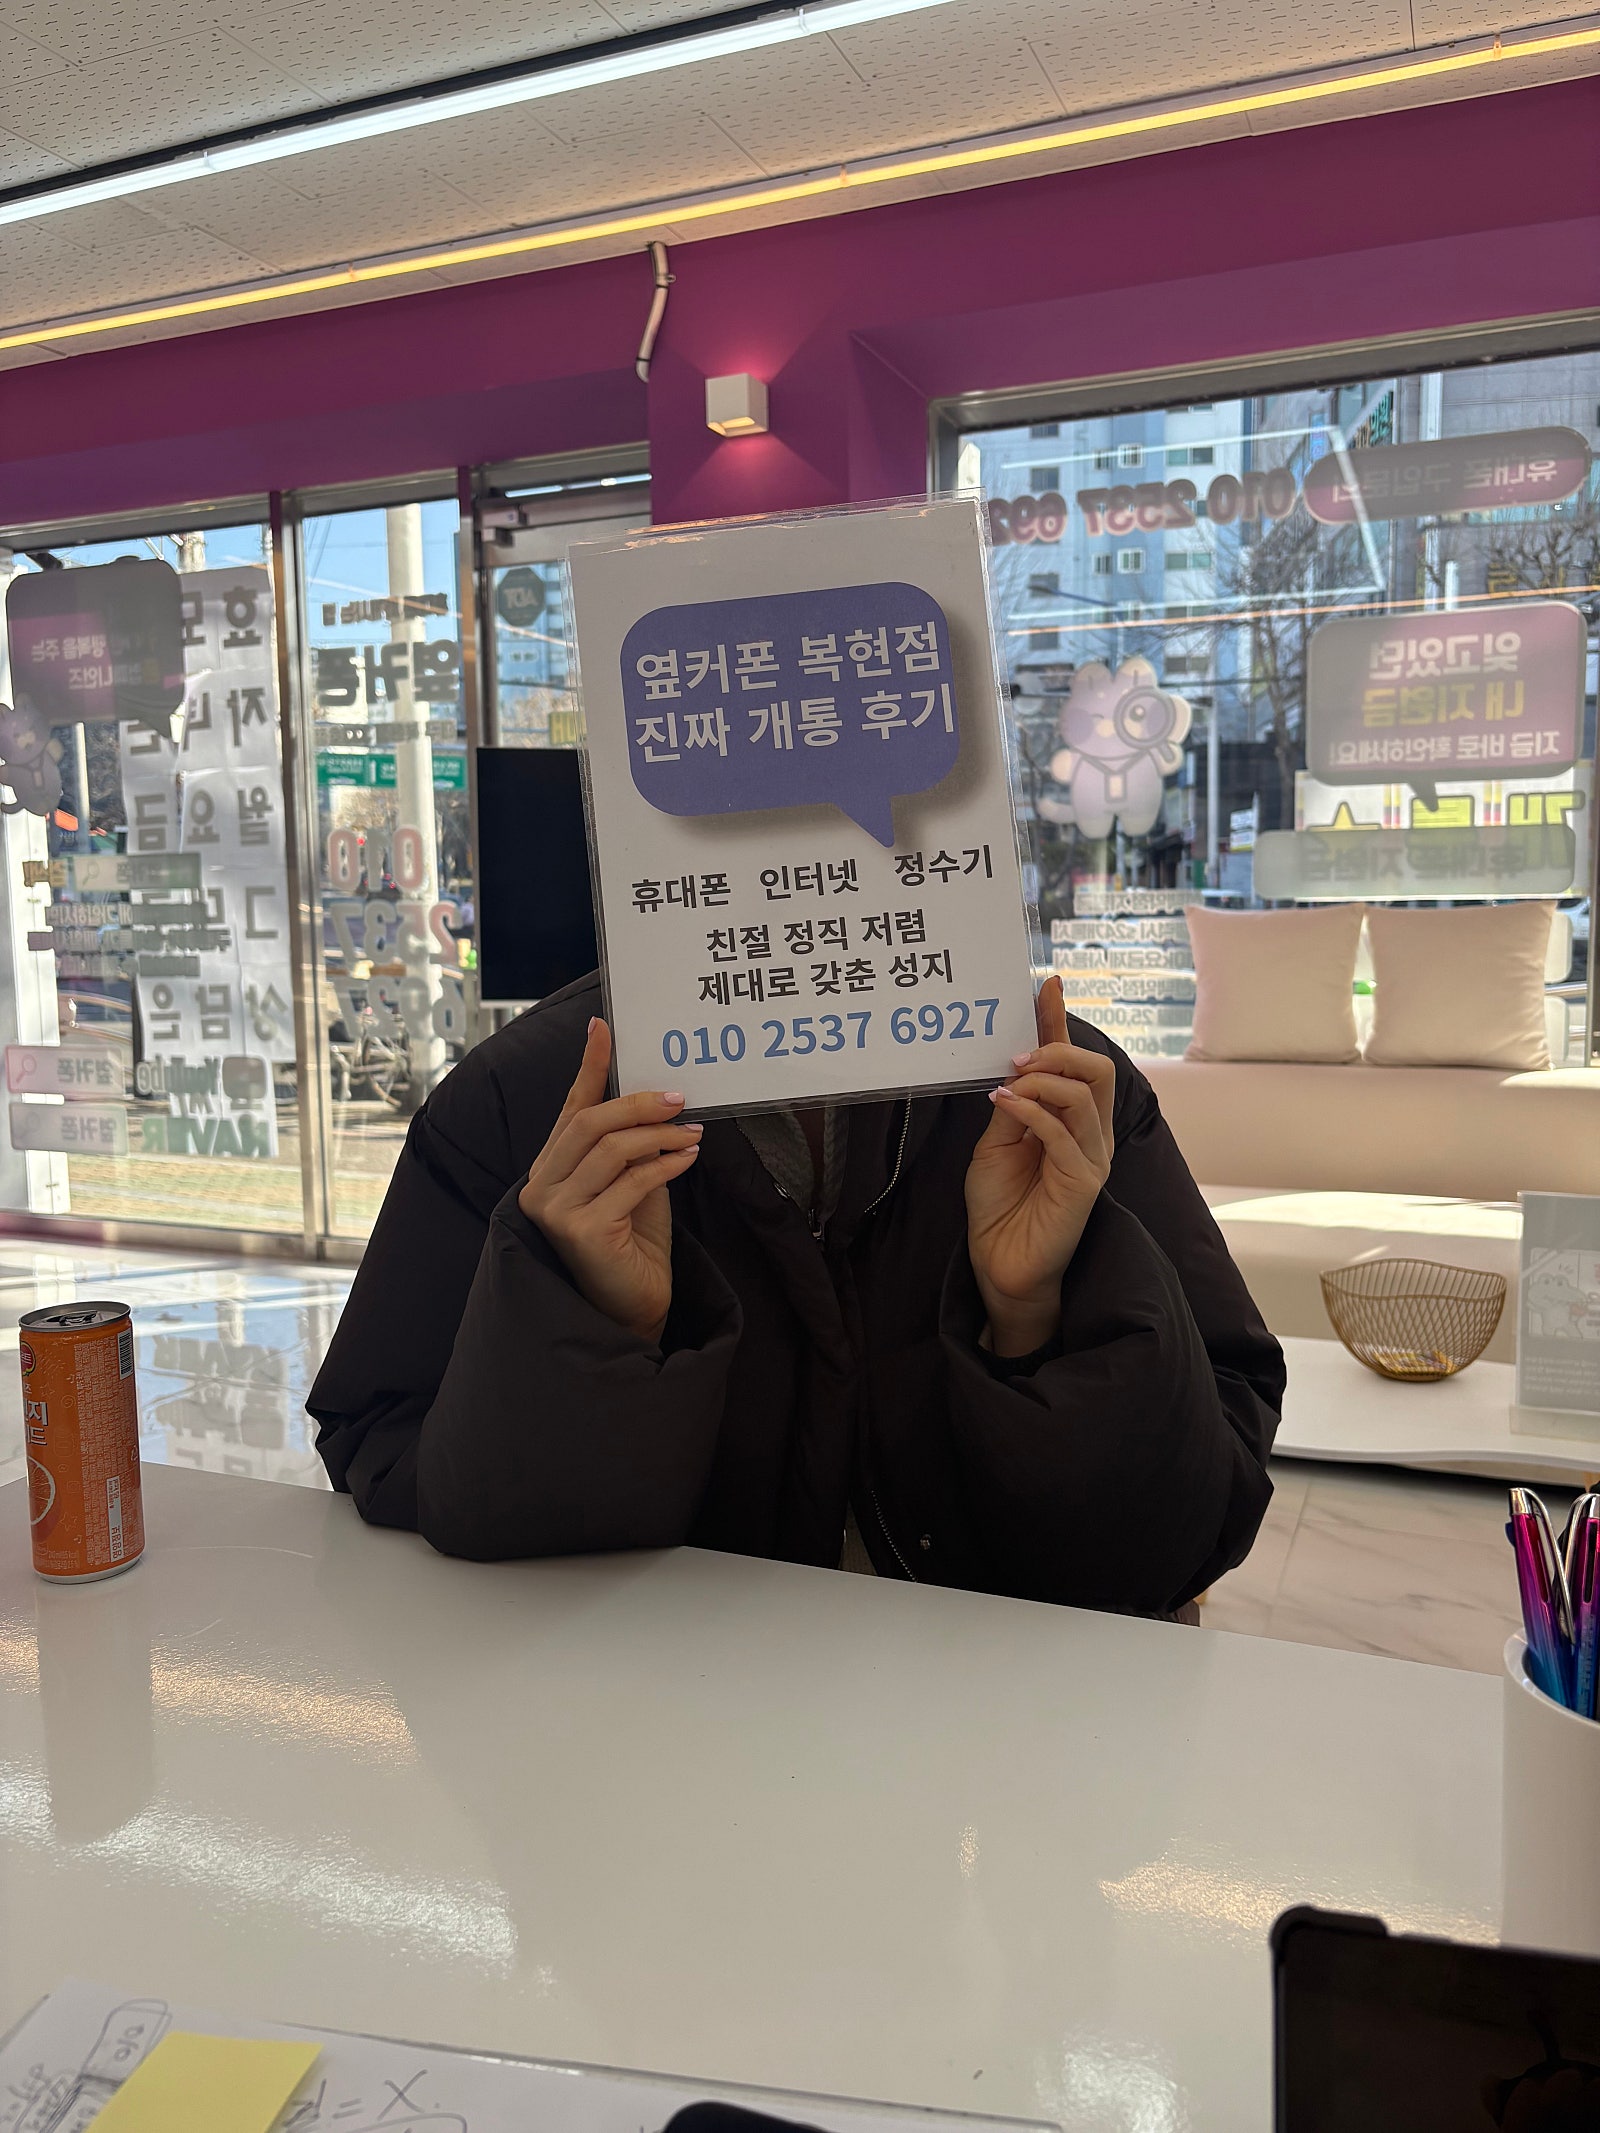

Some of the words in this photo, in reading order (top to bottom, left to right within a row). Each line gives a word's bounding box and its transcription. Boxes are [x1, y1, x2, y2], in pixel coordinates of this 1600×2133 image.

[636, 639, 780, 701] 옆커폰
[799, 621, 941, 679] 복현점
[636, 707, 731, 764] 진짜
[749, 696, 843, 750] 개통
[861, 683, 955, 741] 후기
[631, 872, 731, 914] 휴대폰
[759, 857, 859, 900] 인터넷
[894, 844, 994, 889] 정수기
[706, 922, 772, 963] 친절
[784, 916, 849, 956] 정직
[862, 908, 927, 947] 저렴
[698, 965, 799, 1006] 제대로
[810, 959, 876, 998] 갖춘
[889, 949, 954, 989] 성지
[662, 1024, 746, 1069] 010
[762, 1011, 873, 1059] 2537
[890, 997, 1000, 1047] 6927
